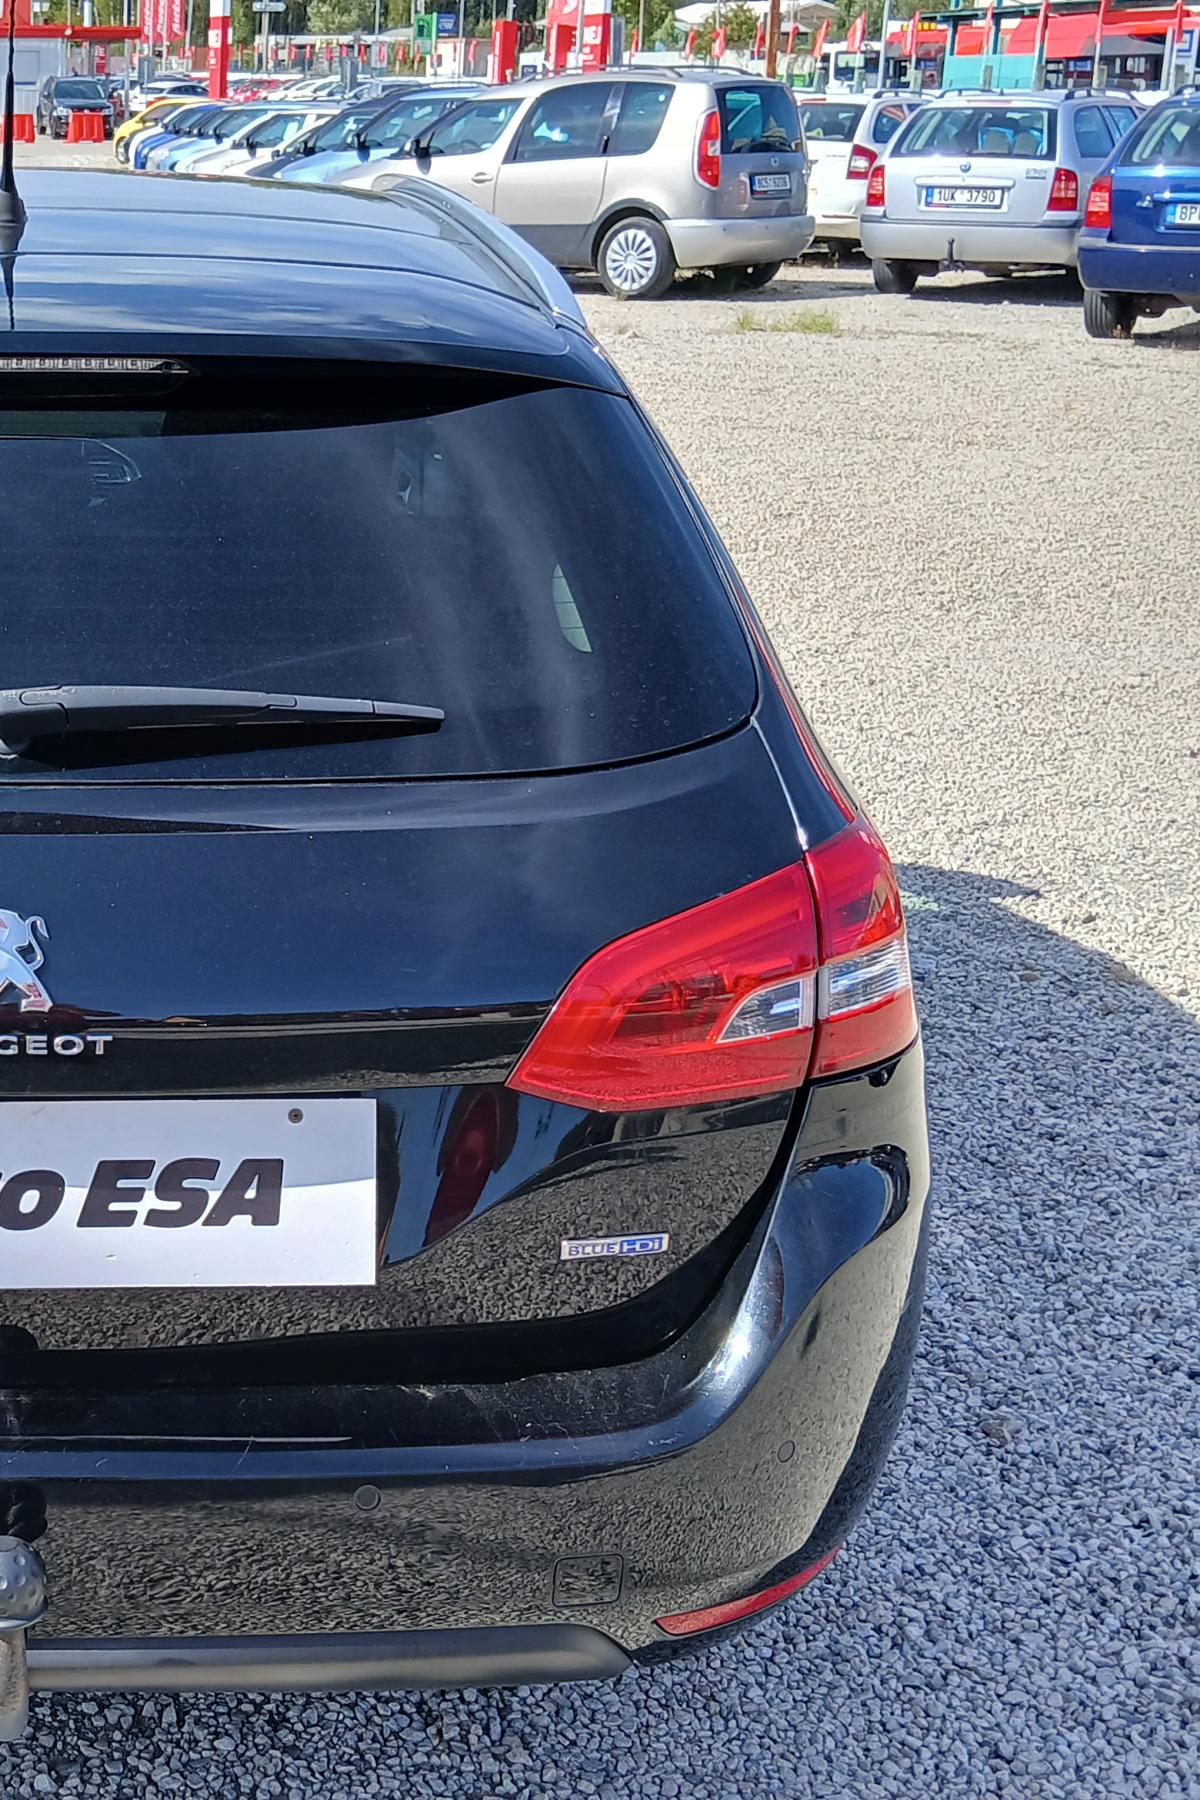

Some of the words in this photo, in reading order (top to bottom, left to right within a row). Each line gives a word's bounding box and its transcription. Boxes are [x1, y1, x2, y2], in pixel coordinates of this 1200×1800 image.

[938, 190, 956, 202] 1UK
[966, 190, 996, 203] 3790
[1179, 205, 1200, 221] 8P
[76, 1157, 285, 1229] ESA
